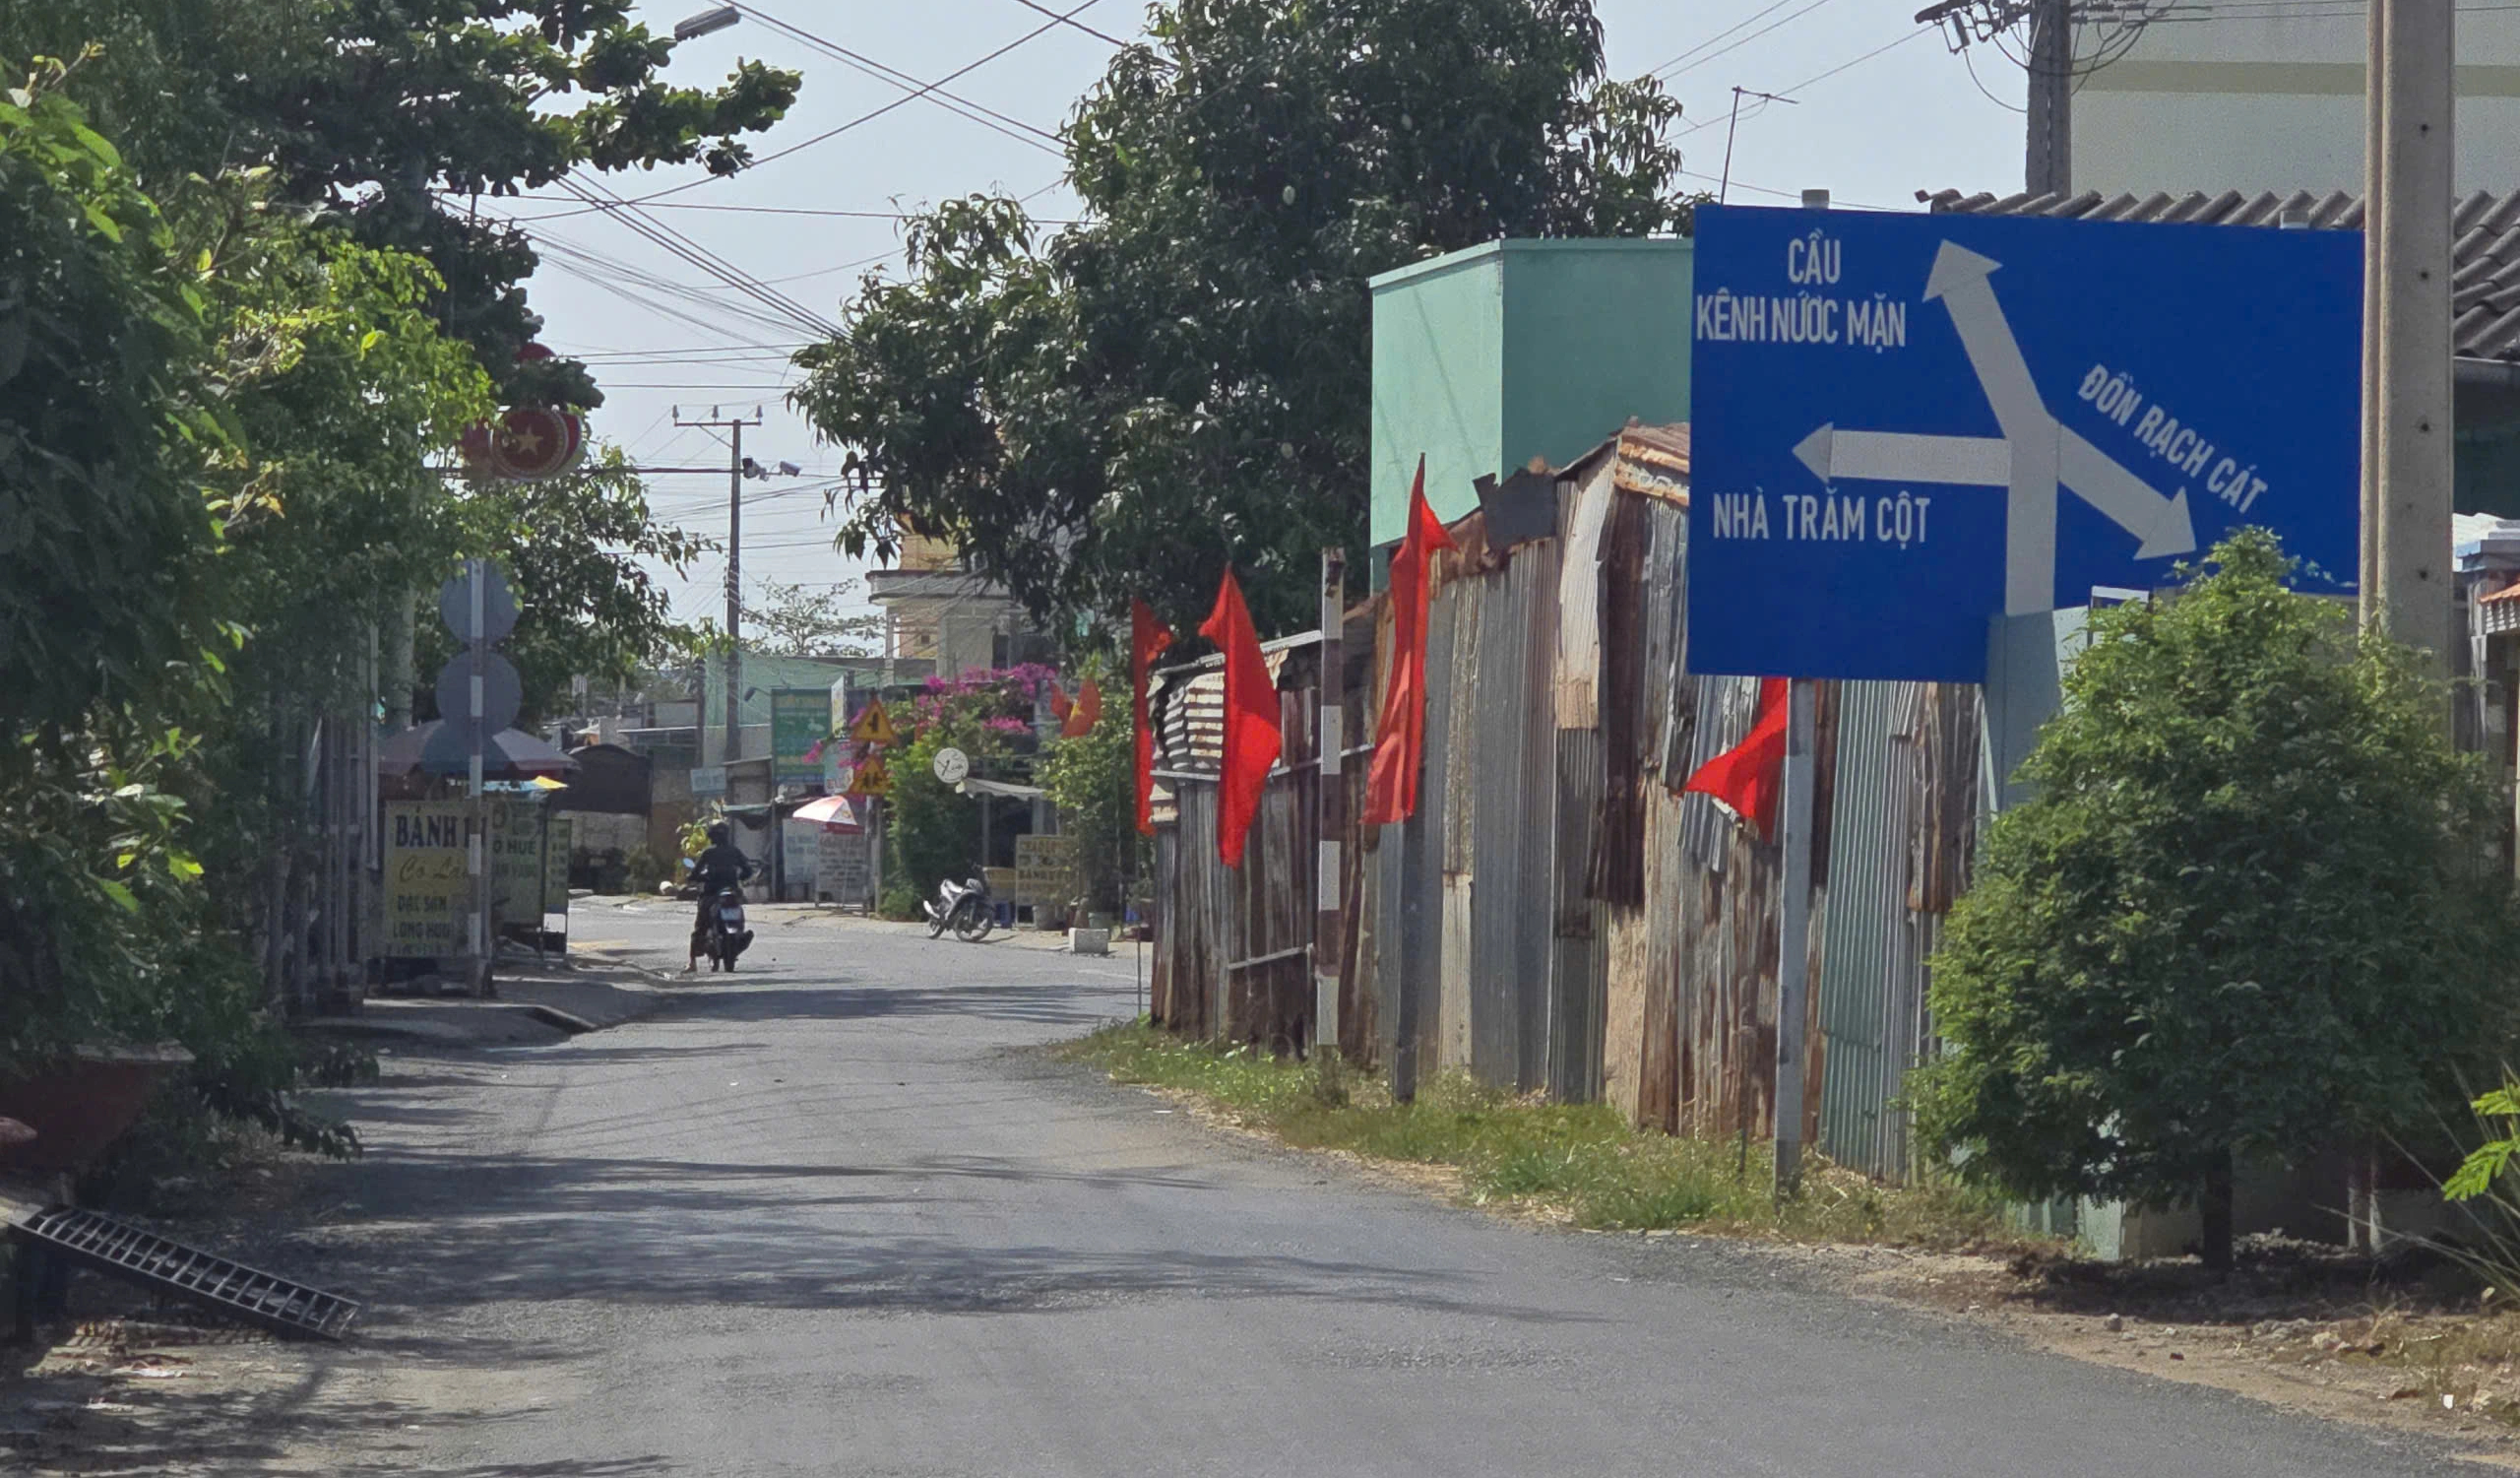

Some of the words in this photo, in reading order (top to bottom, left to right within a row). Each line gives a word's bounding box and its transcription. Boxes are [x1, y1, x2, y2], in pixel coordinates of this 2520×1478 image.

[1788, 227, 1842, 285] CẦU
[1696, 287, 1766, 341] KÊNH
[1847, 292, 1907, 353] MẶN
[2078, 363, 2143, 426] ĐỒN
[2133, 405, 2215, 478] RẠCH
[2207, 457, 2269, 514] CÁT
[1713, 486, 1770, 539] NHÀ
[1783, 486, 1865, 542] TRĂM
[1876, 490, 1931, 550] CỘT
[395, 805, 458, 848] BÁNH
